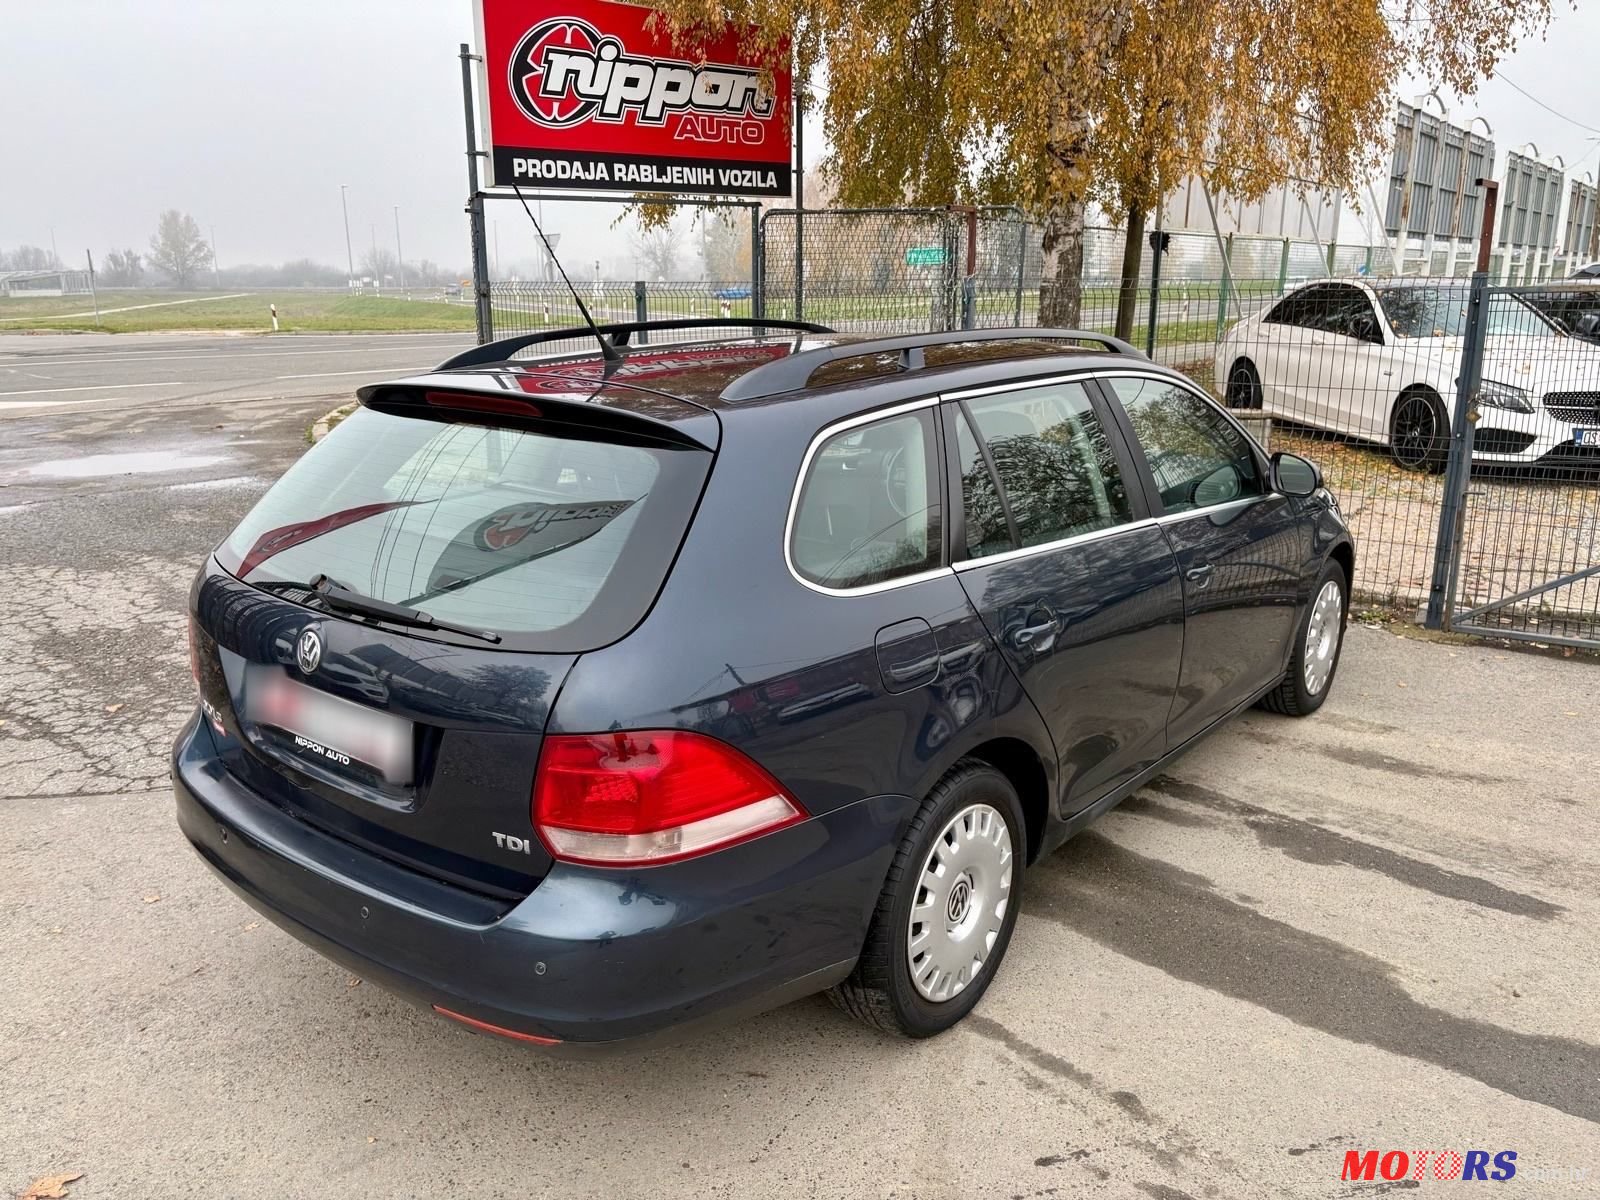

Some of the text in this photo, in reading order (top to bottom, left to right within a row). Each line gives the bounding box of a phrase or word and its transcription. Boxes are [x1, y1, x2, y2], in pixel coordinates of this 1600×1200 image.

[674, 115, 765, 145] AUTO
[512, 157, 778, 189] PRODAJA RABLJENIH VOZILA
[294, 735, 350, 765] NIPPON AUTO
[491, 831, 531, 855] TDI
